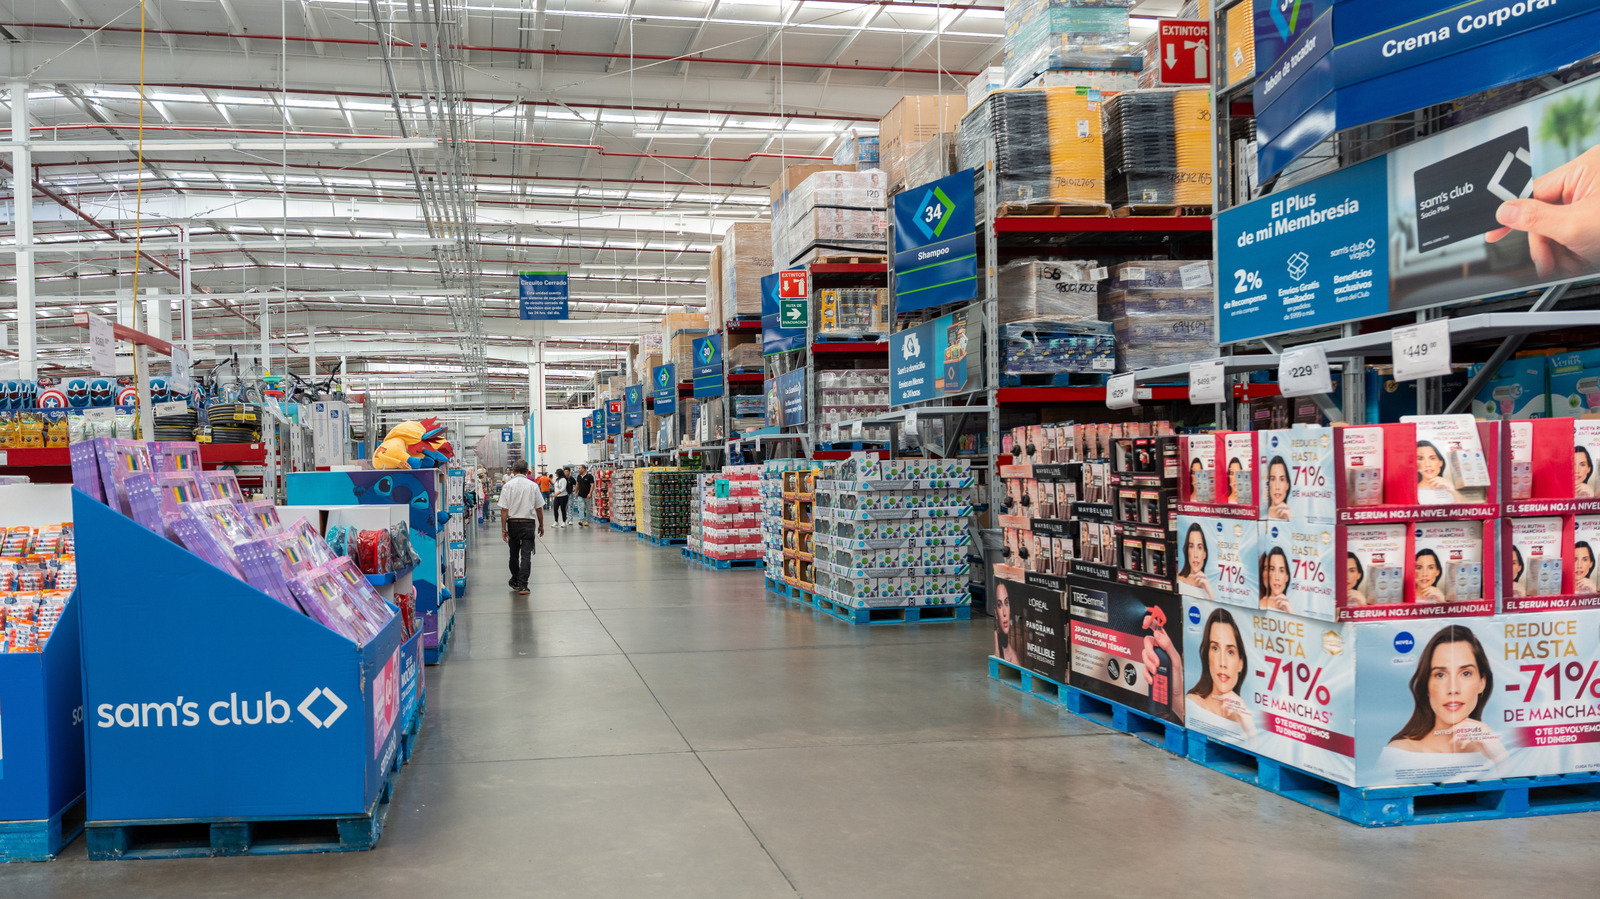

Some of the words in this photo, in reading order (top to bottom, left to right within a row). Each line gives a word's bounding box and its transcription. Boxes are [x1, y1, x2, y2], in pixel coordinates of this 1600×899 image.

[1162, 25, 1208, 36] EXTINTOR
[1382, 26, 1450, 57] Crema
[1264, 71, 1282, 95] Jabón
[1282, 61, 1291, 75] de
[1291, 36, 1317, 66] tocador
[1420, 192, 1448, 211] sam's
[1449, 182, 1474, 199] club
[925, 203, 942, 223] 34
[1271, 202, 1284, 218] El
[1286, 193, 1316, 214] Plus
[1437, 205, 1450, 214] Plus
[1237, 231, 1254, 248] de
[1256, 223, 1272, 242] mi
[1275, 198, 1359, 236] Membresía
[918, 246, 950, 261] Shampoo
[1349, 242, 1365, 253] club
[1234, 269, 1263, 294] 2%
[1333, 269, 1372, 284] Beneficios
[1278, 286, 1299, 297] Envíos
[1300, 280, 1320, 291] Gratis
[1333, 281, 1372, 295] exclusivos
[1357, 291, 1370, 299] Club
[1223, 301, 1231, 310] de
[1231, 294, 1267, 308] Recompensa
[1403, 344, 1428, 358] $449
[1288, 365, 1313, 378] $229
[1291, 439, 1317, 447] REDUCE
[1291, 451, 1318, 462] HASTA
[1292, 466, 1325, 486] 71%
[1341, 512, 1353, 520] EL
[1354, 511, 1387, 520] SERUM
[1390, 510, 1411, 518] NO.1
[1412, 510, 1419, 518] A
[1421, 508, 1448, 518] NIVEL
[1518, 503, 1548, 512] SERUM
[1550, 503, 1570, 511] NO.1
[1578, 502, 1600, 510] NIVEL
[1291, 533, 1318, 542] REDUCE
[1217, 541, 1239, 551] REDUCE
[1291, 545, 1319, 556] HASTA
[1218, 552, 1239, 562] HASTA
[1076, 564, 1110, 576] MAYBELLINE
[1218, 564, 1245, 585] 71%
[1292, 559, 1325, 582] 71%
[1029, 576, 1059, 587] MAYBELLINE
[1506, 602, 1518, 610] EL
[1519, 600, 1549, 608] SERUM
[1550, 599, 1570, 608] NO.1
[1353, 609, 1386, 618] SERUM
[1388, 609, 1409, 617] NO.1
[1410, 608, 1418, 616] A
[1026, 620, 1055, 635] PANORAMA
[1252, 616, 1305, 638] REDUCE
[1504, 621, 1577, 638] REDUCE
[1092, 630, 1108, 639] SPRAY
[1109, 634, 1117, 642] DE
[1074, 634, 1107, 648] PROTECCIÓN
[1107, 642, 1131, 655] TÉRMICA
[1254, 632, 1306, 659] HASTA
[1504, 640, 1578, 660] HASTA
[1255, 655, 1331, 706] -71%
[1505, 660, 1600, 703] -71%
[1254, 692, 1268, 707] DE
[97, 696, 200, 728] sam's
[208, 691, 291, 726] club
[1504, 709, 1525, 722] DE
[1275, 725, 1283, 734] TU
[1283, 727, 1307, 741] DINERO
[1281, 719, 1288, 727] TE
[1288, 721, 1330, 740] DEVOLVEMOS
[1535, 728, 1542, 736] O
[1554, 724, 1600, 734] DEVOLVEMO
[1536, 737, 1546, 745] TU
[1547, 735, 1578, 744] DINERO
